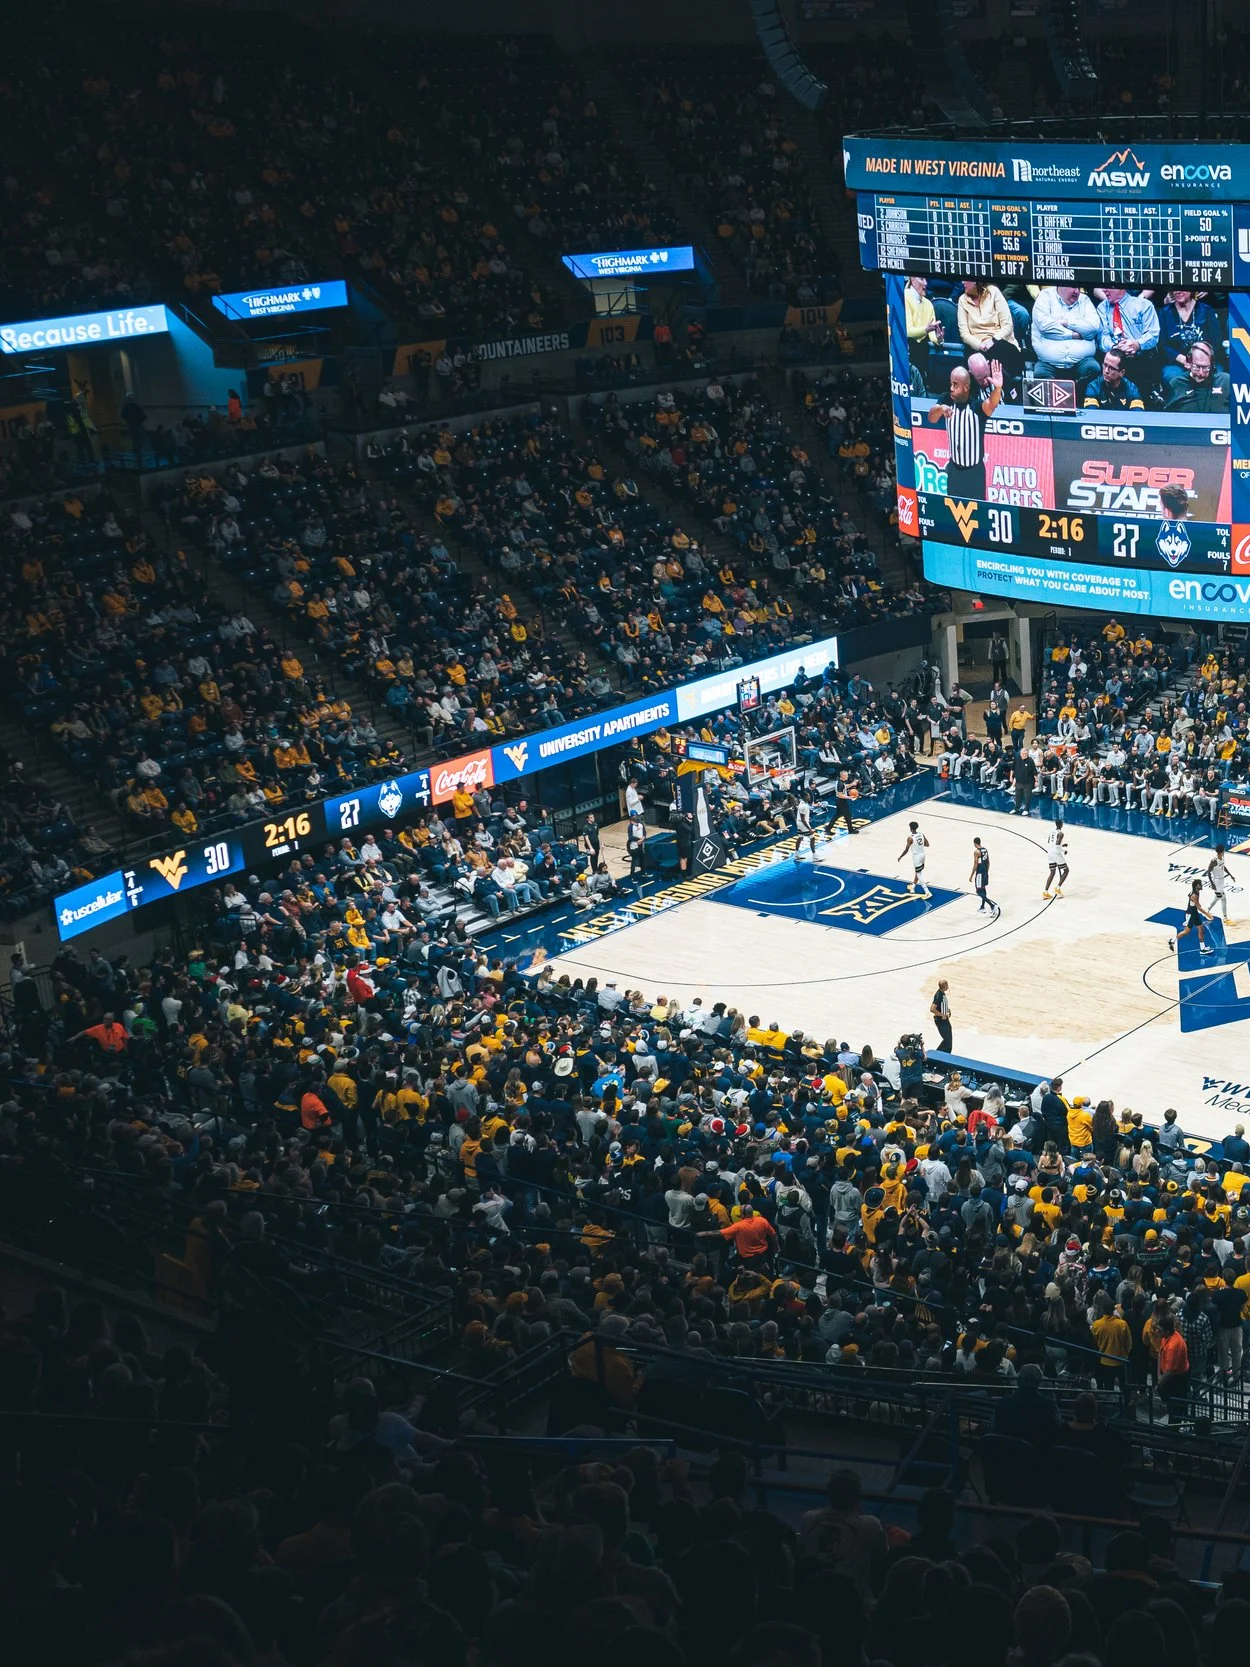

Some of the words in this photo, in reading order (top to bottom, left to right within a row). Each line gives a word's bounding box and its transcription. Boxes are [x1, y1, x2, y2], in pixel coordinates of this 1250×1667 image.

[866, 158, 896, 174] MADE
[900, 160, 911, 174] IN
[915, 160, 945, 176] WEST
[949, 162, 1005, 178] VIRGINIA
[1032, 164, 1080, 178] northeast
[1160, 164, 1231, 182] encova
[1087, 172, 1150, 187] MSW
[1036, 204, 1058, 212] PLAYER
[1124, 207, 1138, 215] REB.
[1144, 207, 1157, 215] AST.
[1001, 213, 1018, 226] 42.3
[1200, 217, 1212, 231] 50
[1044, 229, 1061, 241] COLE
[1002, 237, 1020, 251] 55.6
[1201, 243, 1211, 256] 10
[598, 254, 648, 268] HIGHMARK
[1045, 255, 1069, 267] POLLEY
[1036, 268, 1045, 279] 24
[1193, 269, 1198, 281] 2
[1200, 269, 1213, 282] OF
[1214, 270, 1221, 282] 4
[247, 291, 301, 308] HIGHMARK
[0, 319, 101, 352] Because
[108, 309, 156, 336] Life.
[985, 420, 1024, 435] EICO
[1081, 425, 1144, 442] GEICO
[992, 465, 1037, 488] AUTO
[1081, 460, 1194, 489] SUPER
[1240, 471, 1250, 479] OF
[988, 487, 1043, 509] PARTS
[918, 518, 935, 527] FOULS
[988, 509, 1013, 544] 30
[1038, 515, 1084, 542] 2:16
[1216, 528, 1230, 536] TOL
[1113, 523, 1139, 558] 27
[1221, 537, 1226, 547] 4
[1207, 551, 1230, 560] FOULS
[1222, 560, 1227, 570] 7
[976, 559, 1024, 575] ENCIRCLING
[1026, 566, 1044, 577] YOU
[1046, 568, 1070, 580] WITH
[1071, 571, 1121, 586] COVERAGE
[1123, 579, 1136, 588] TO
[977, 571, 1013, 583] PROTECT
[1014, 576, 1039, 586] WHAT
[1041, 579, 1060, 590] YOU
[1062, 581, 1087, 593] CARE
[1088, 585, 1121, 596] ABOUT
[1123, 589, 1151, 600] MOST.
[538, 728, 601, 758] UNIVERSITY
[603, 702, 670, 737] APARTMENTS
[339, 798, 360, 829] 27
[263, 813, 311, 848] 2:16
[203, 842, 229, 874] 30
[558, 911, 623, 942] WEST
[618, 872, 727, 917] VIRGINIA
